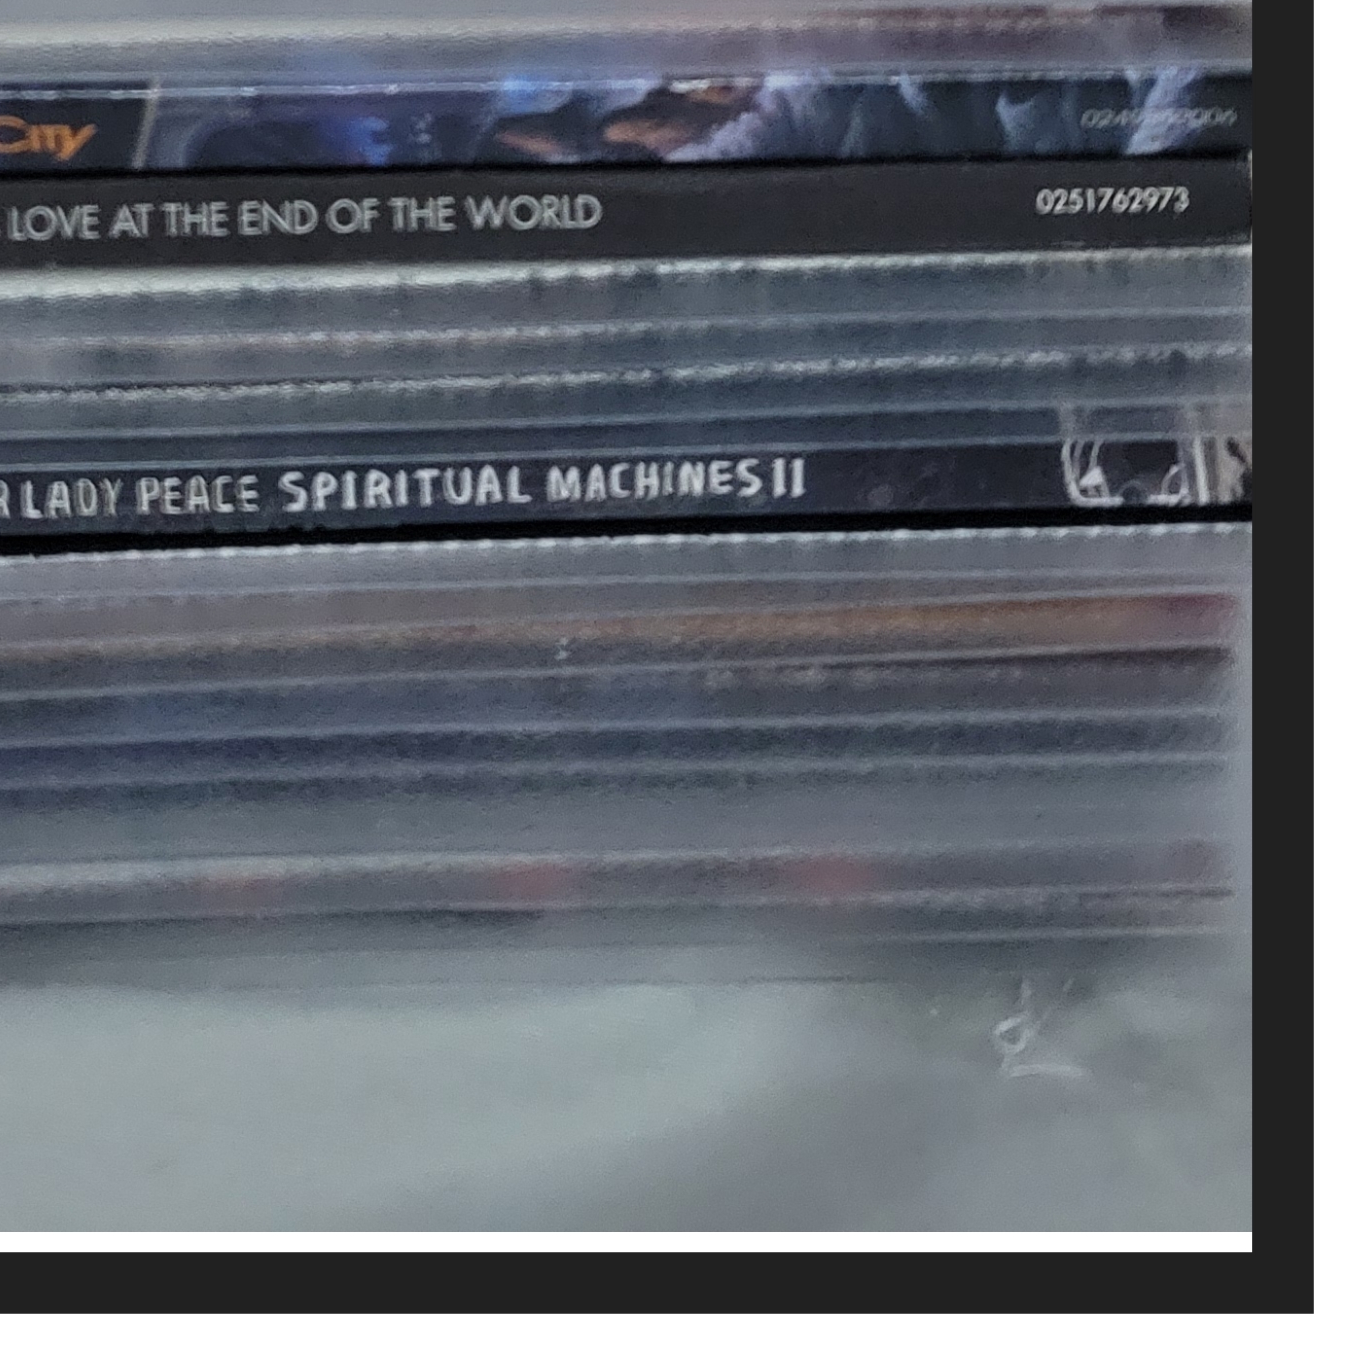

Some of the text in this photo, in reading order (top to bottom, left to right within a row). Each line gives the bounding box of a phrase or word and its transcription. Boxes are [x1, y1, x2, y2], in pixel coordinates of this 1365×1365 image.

[6, 204, 100, 241] LOVE
[107, 203, 160, 239] AT
[160, 201, 229, 237] THE
[237, 199, 319, 235] END
[324, 198, 380, 234] OF
[385, 196, 456, 232] THE
[462, 193, 604, 230] WORLD
[1035, 186, 1191, 215] 0251762973
[19, 477, 124, 519] LADY
[134, 474, 260, 516] PEACE
[277, 463, 533, 513] SPIRITUAL
[546, 457, 764, 502] MACHINES
